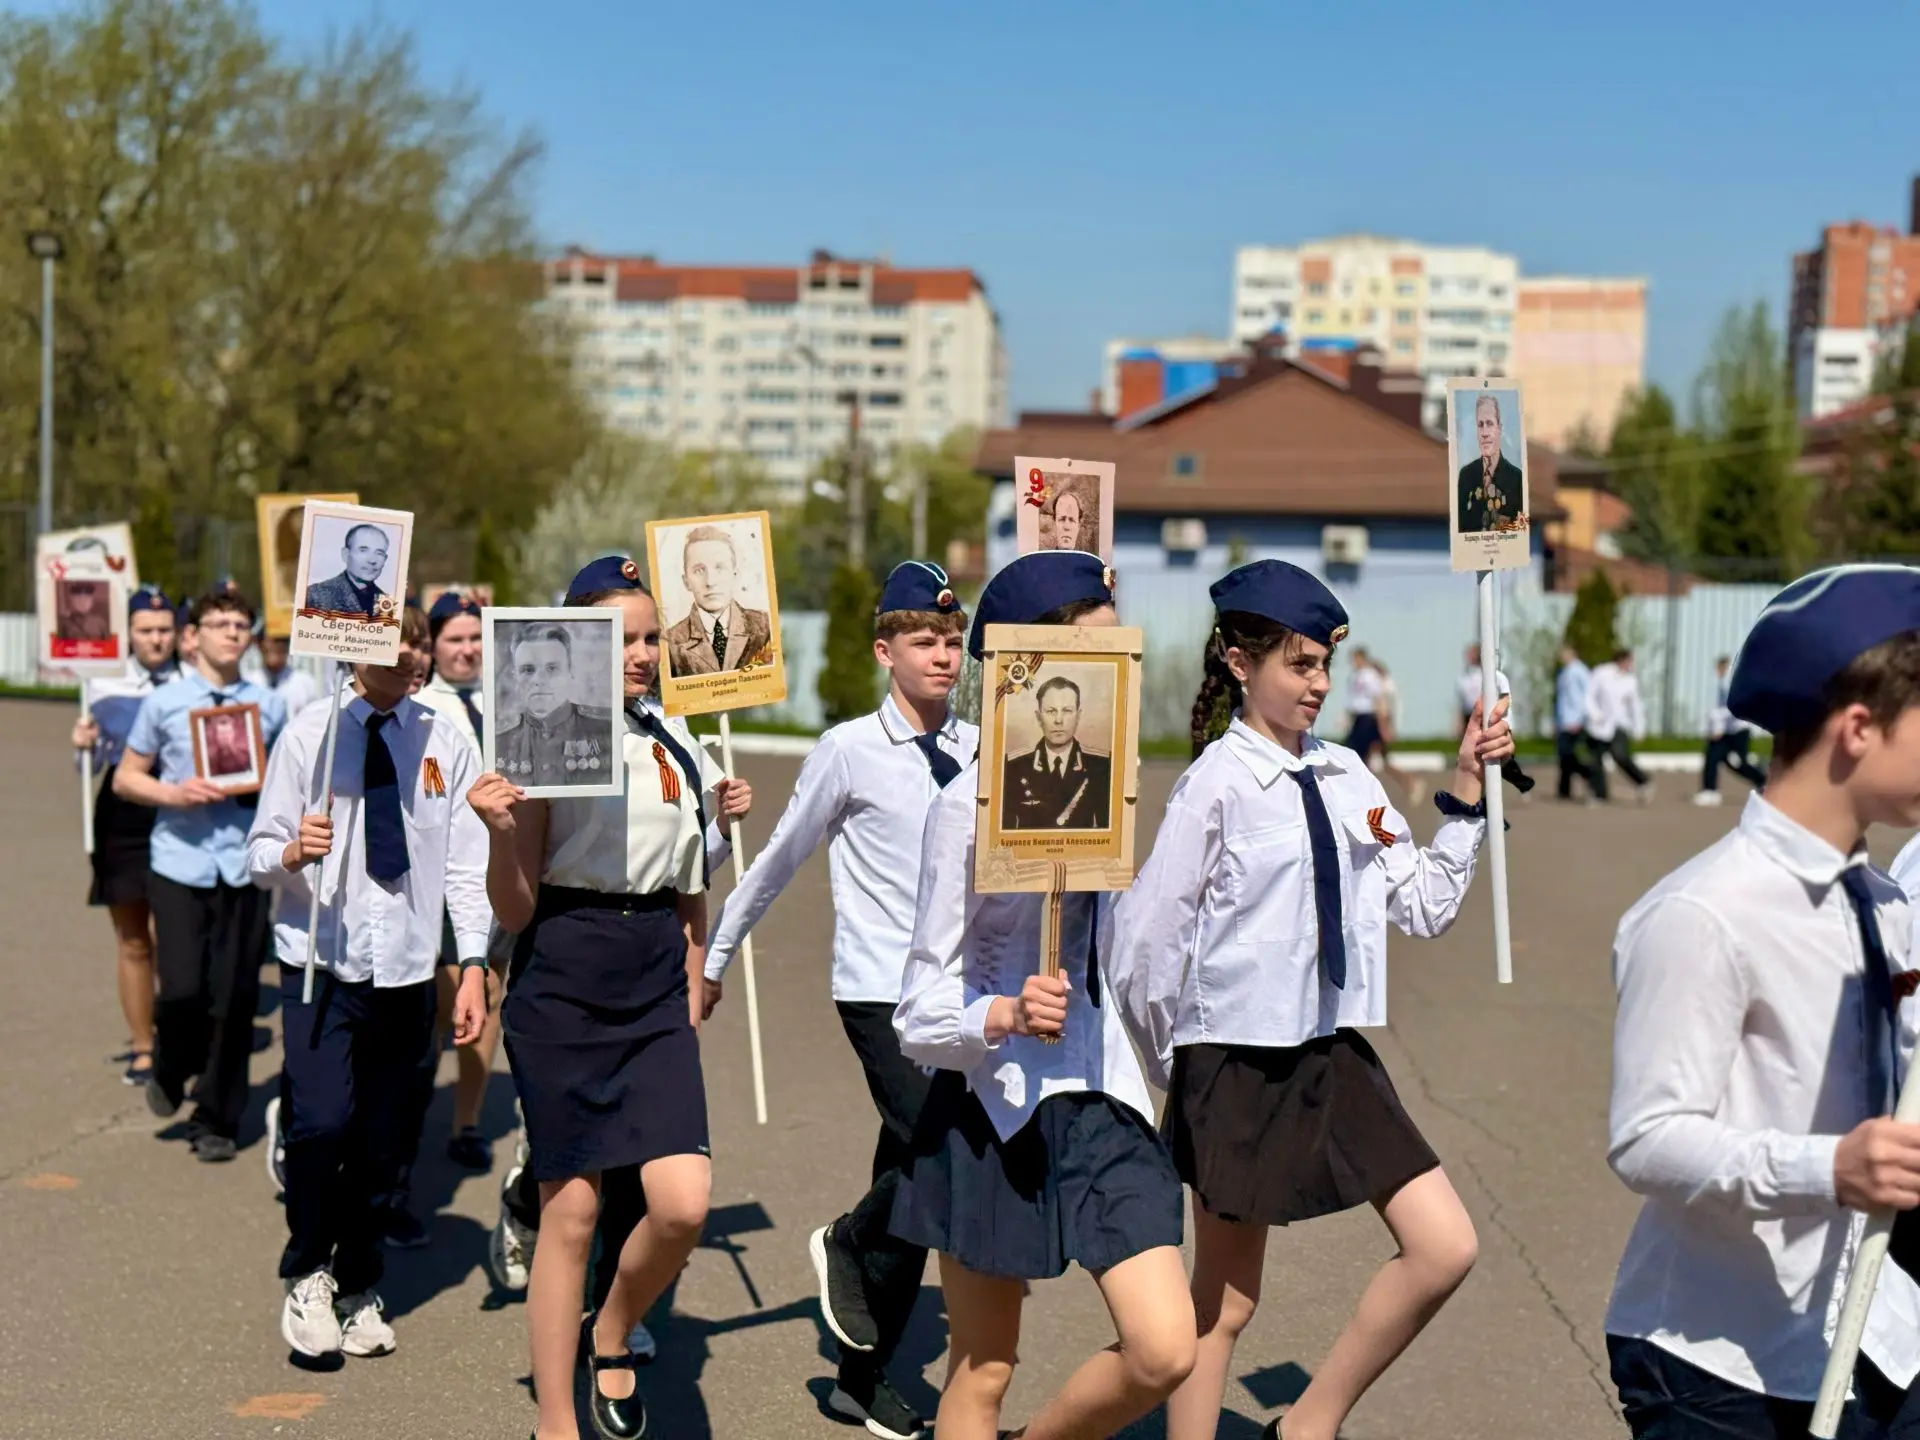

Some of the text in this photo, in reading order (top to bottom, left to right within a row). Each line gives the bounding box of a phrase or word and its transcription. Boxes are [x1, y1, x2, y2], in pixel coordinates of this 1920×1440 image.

[1029, 468, 1045, 493] 9
[321, 618, 384, 634] Сверчков
[298, 629, 392, 647] Василий Иванович
[328, 643, 370, 654] сержант
[676, 673, 771, 692] Казаков Серафим Павлович
[1033, 838, 1064, 846] Николай
[1066, 837, 1111, 846] Алексеевич
